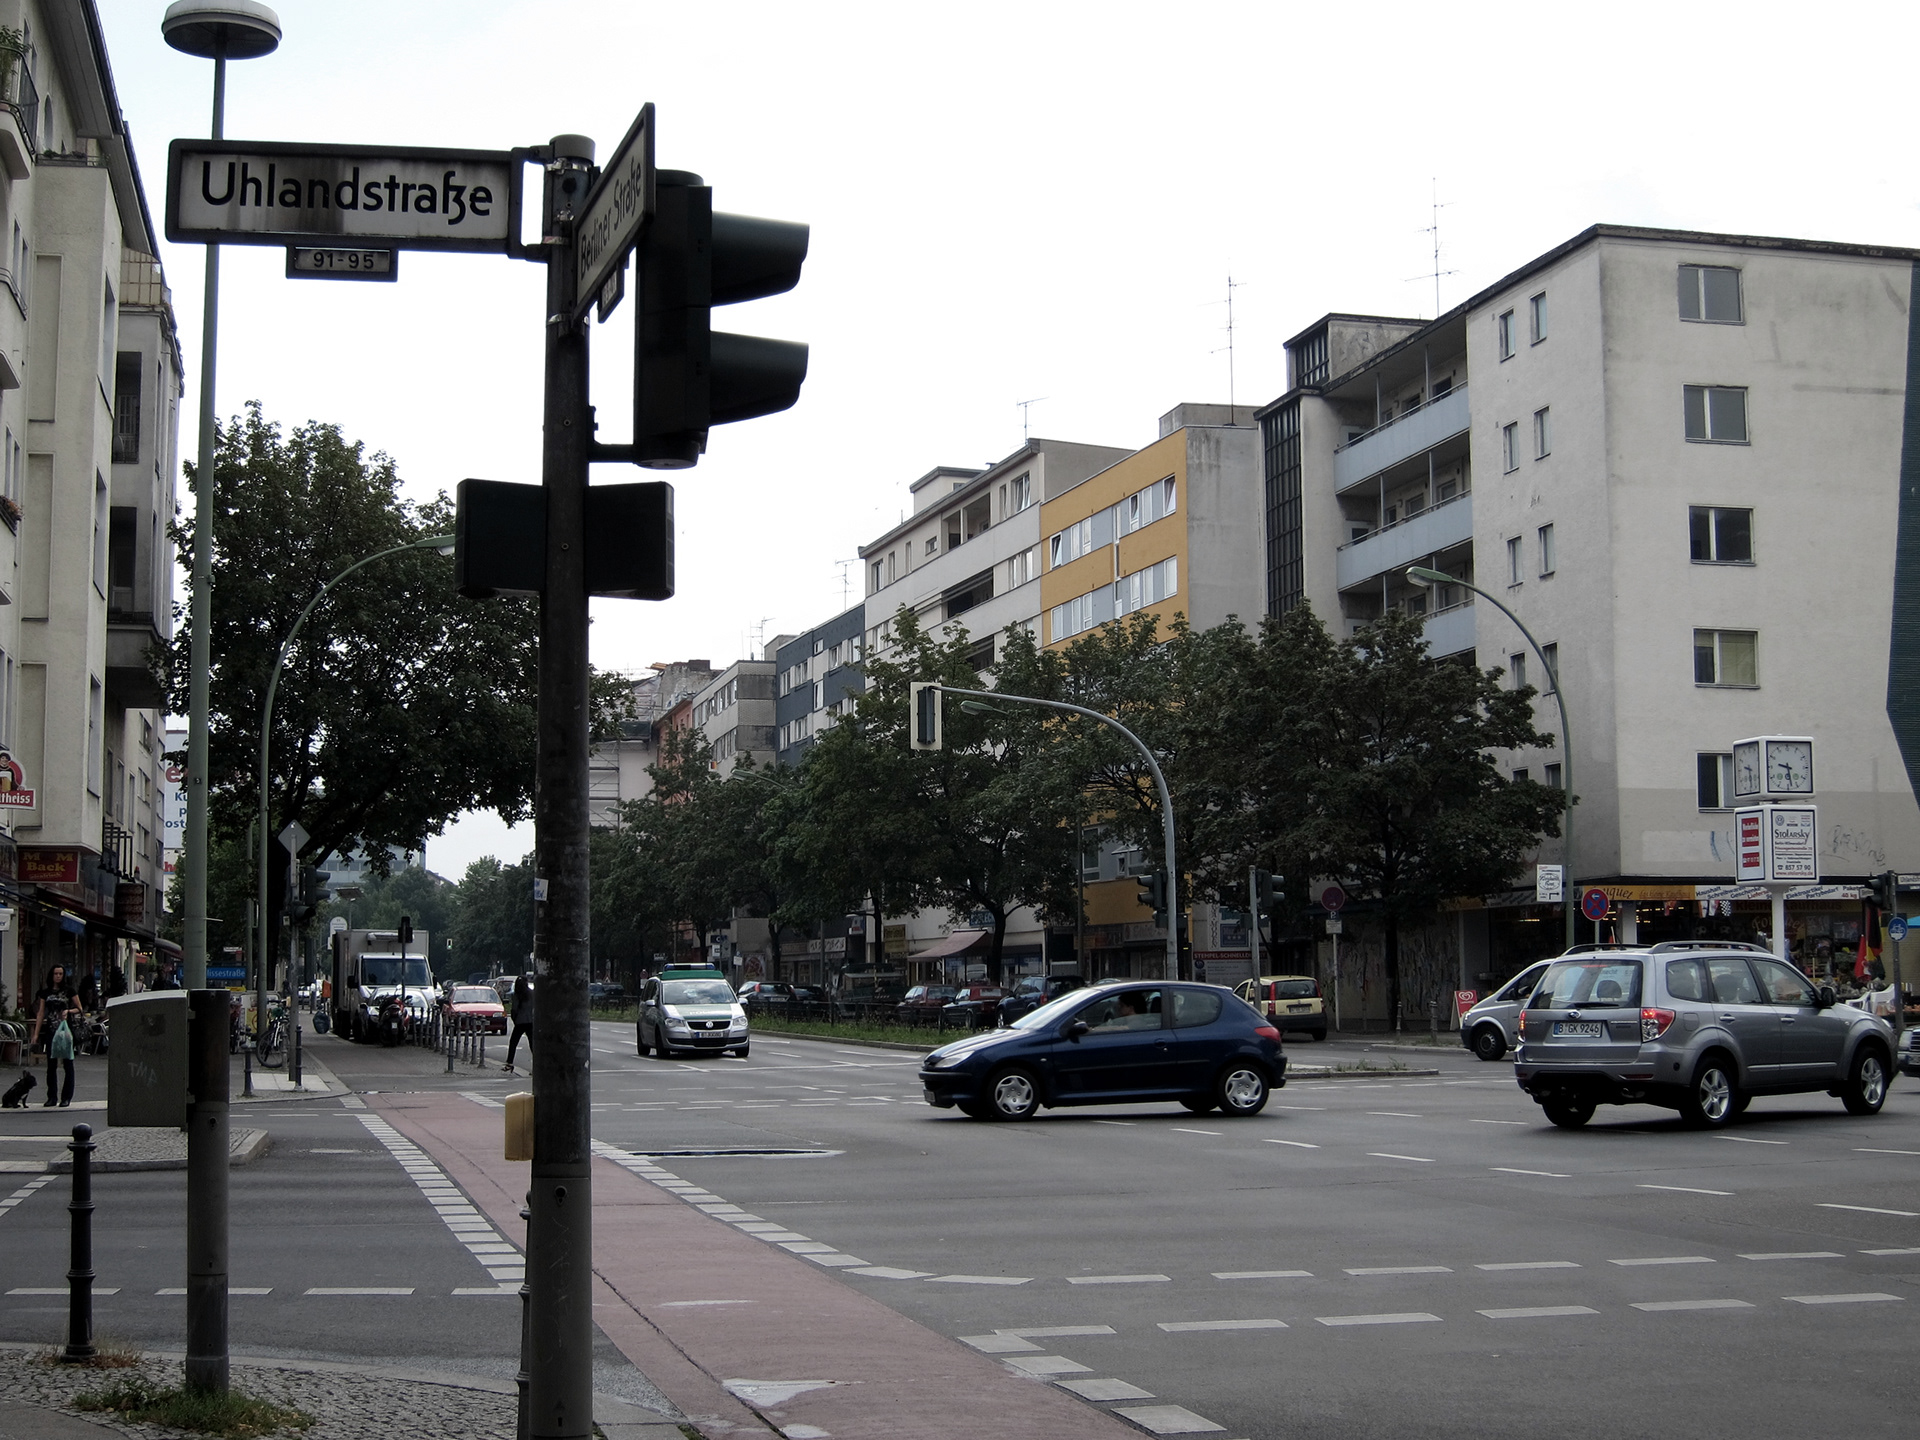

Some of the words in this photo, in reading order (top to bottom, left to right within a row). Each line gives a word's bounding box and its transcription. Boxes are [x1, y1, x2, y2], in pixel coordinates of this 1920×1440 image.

[201, 160, 494, 225] Uhlandstraße
[581, 206, 612, 281] Berliner
[614, 156, 642, 231] Straße
[313, 251, 375, 270] 91-95
[26, 862, 66, 872] Back
[206, 968, 246, 977] lissestraße
[1559, 1024, 1564, 1033] B
[1568, 1024, 1578, 1033] GK
[1580, 1024, 1599, 1034] 9246
